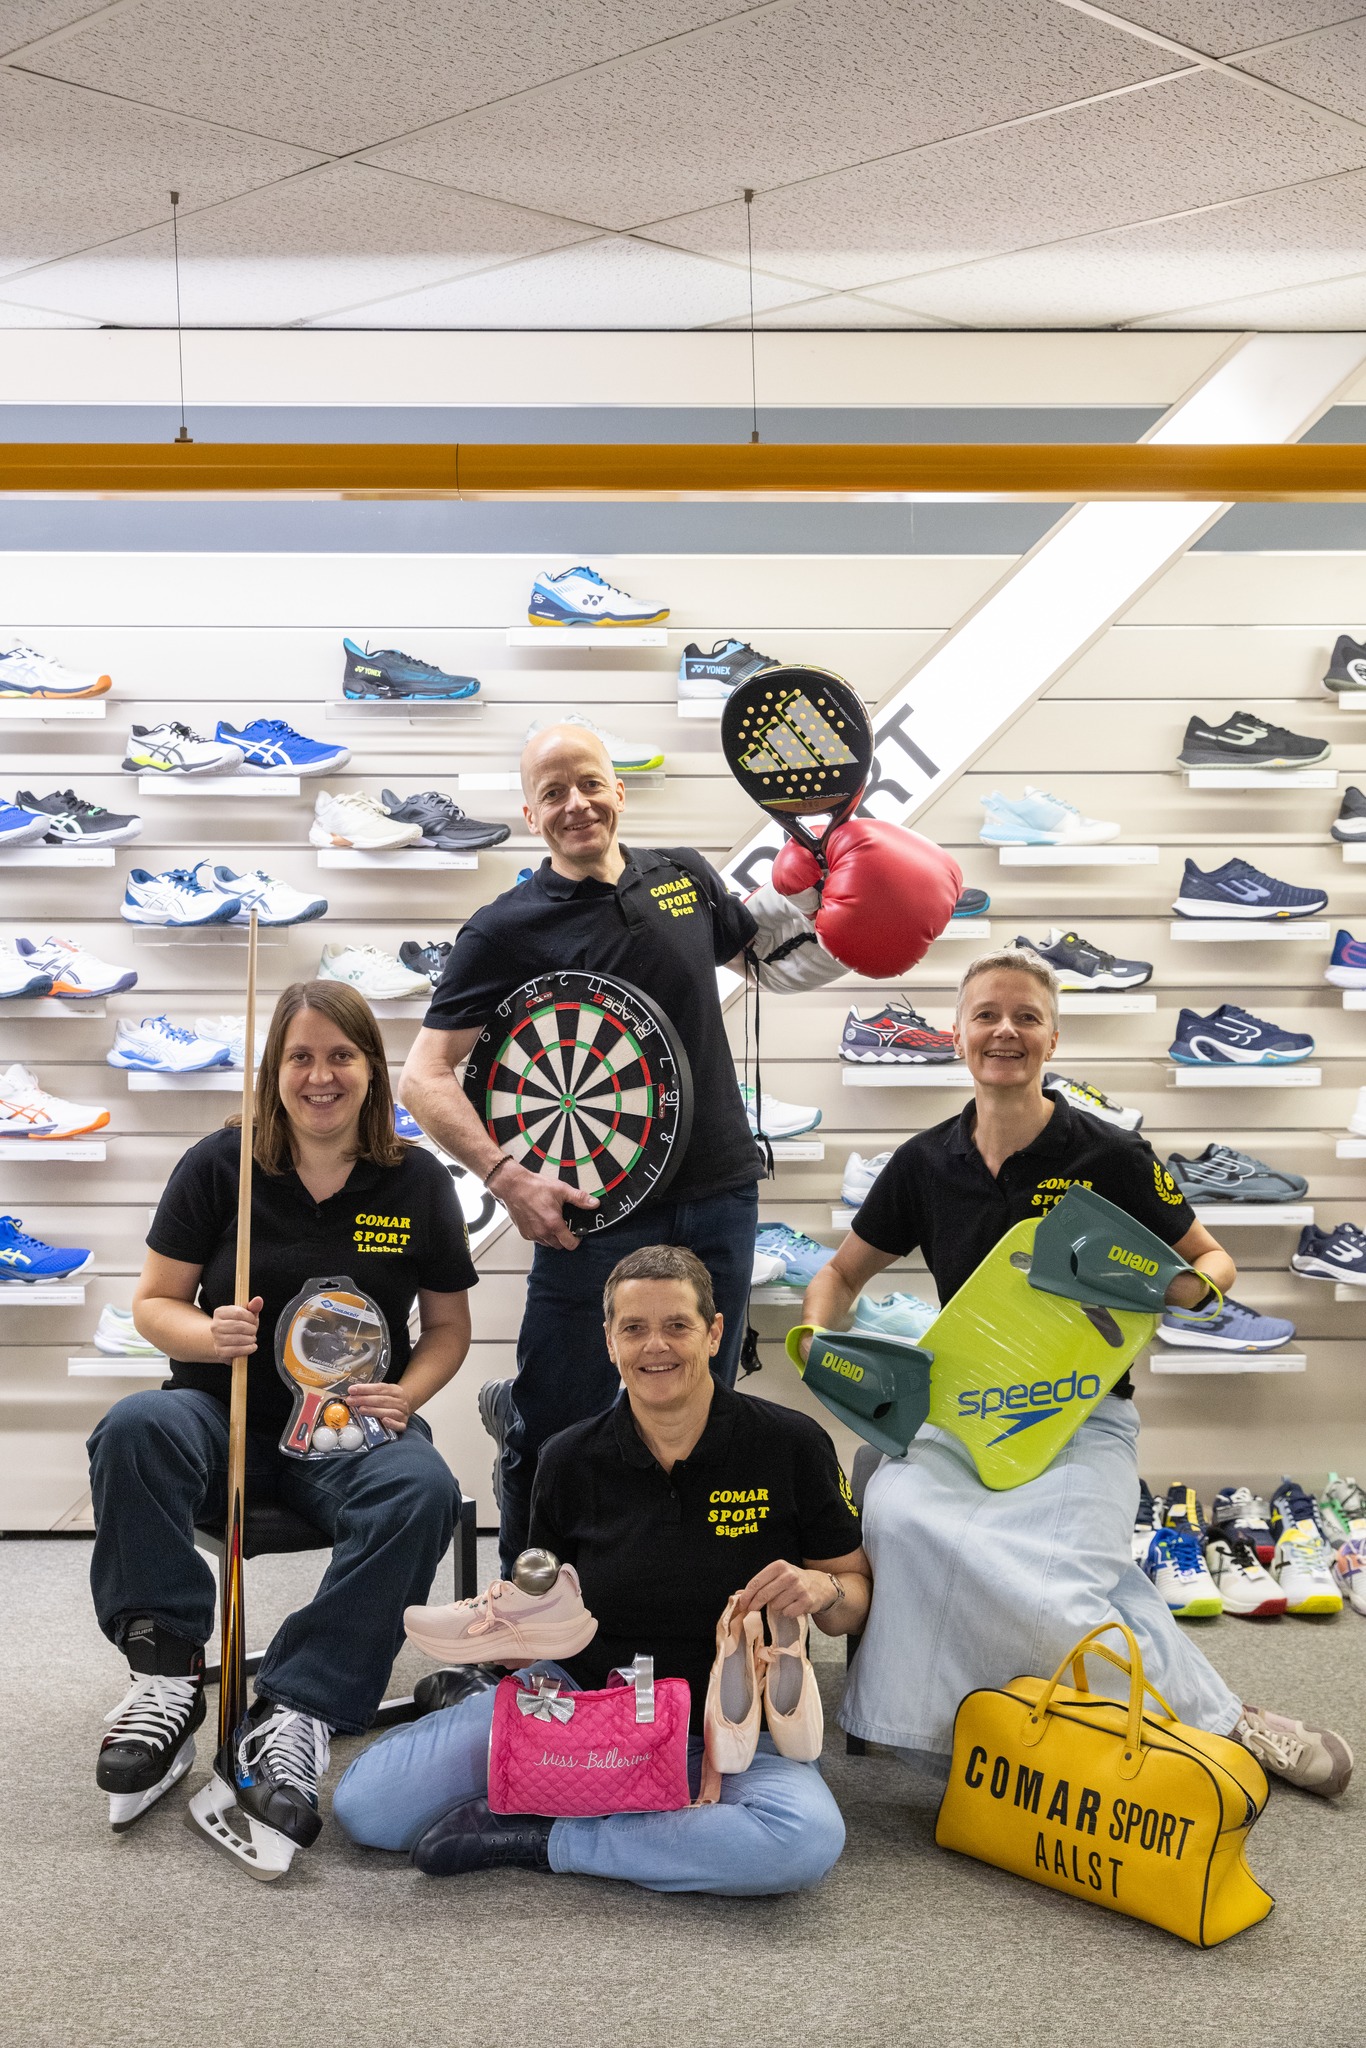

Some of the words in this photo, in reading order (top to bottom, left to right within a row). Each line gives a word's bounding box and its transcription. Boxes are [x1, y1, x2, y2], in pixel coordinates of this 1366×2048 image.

[705, 665, 731, 676] YONEX
[650, 877, 693, 898] COMAR
[658, 890, 698, 911] SPORT
[671, 906, 694, 918] Sven
[660, 1132, 673, 1144] 8
[1031, 1194, 1065, 1206] SPO
[355, 1213, 411, 1229] COMAR
[353, 1230, 411, 1246] SPORT
[357, 1243, 404, 1254] Liesbet
[1107, 1244, 1159, 1277] arena
[820, 1351, 865, 1383] arena
[957, 1370, 1101, 1420] speedo
[709, 1488, 769, 1503] COMAR
[707, 1506, 770, 1522] SPORT
[715, 1522, 759, 1538] Sigrid
[533, 1750, 579, 1768] Miss
[579, 1747, 652, 1770] Ballerina
[964, 1745, 1102, 1836] COMAR
[1108, 1798, 1196, 1861] SPORT
[1035, 1831, 1124, 1899] AALST
